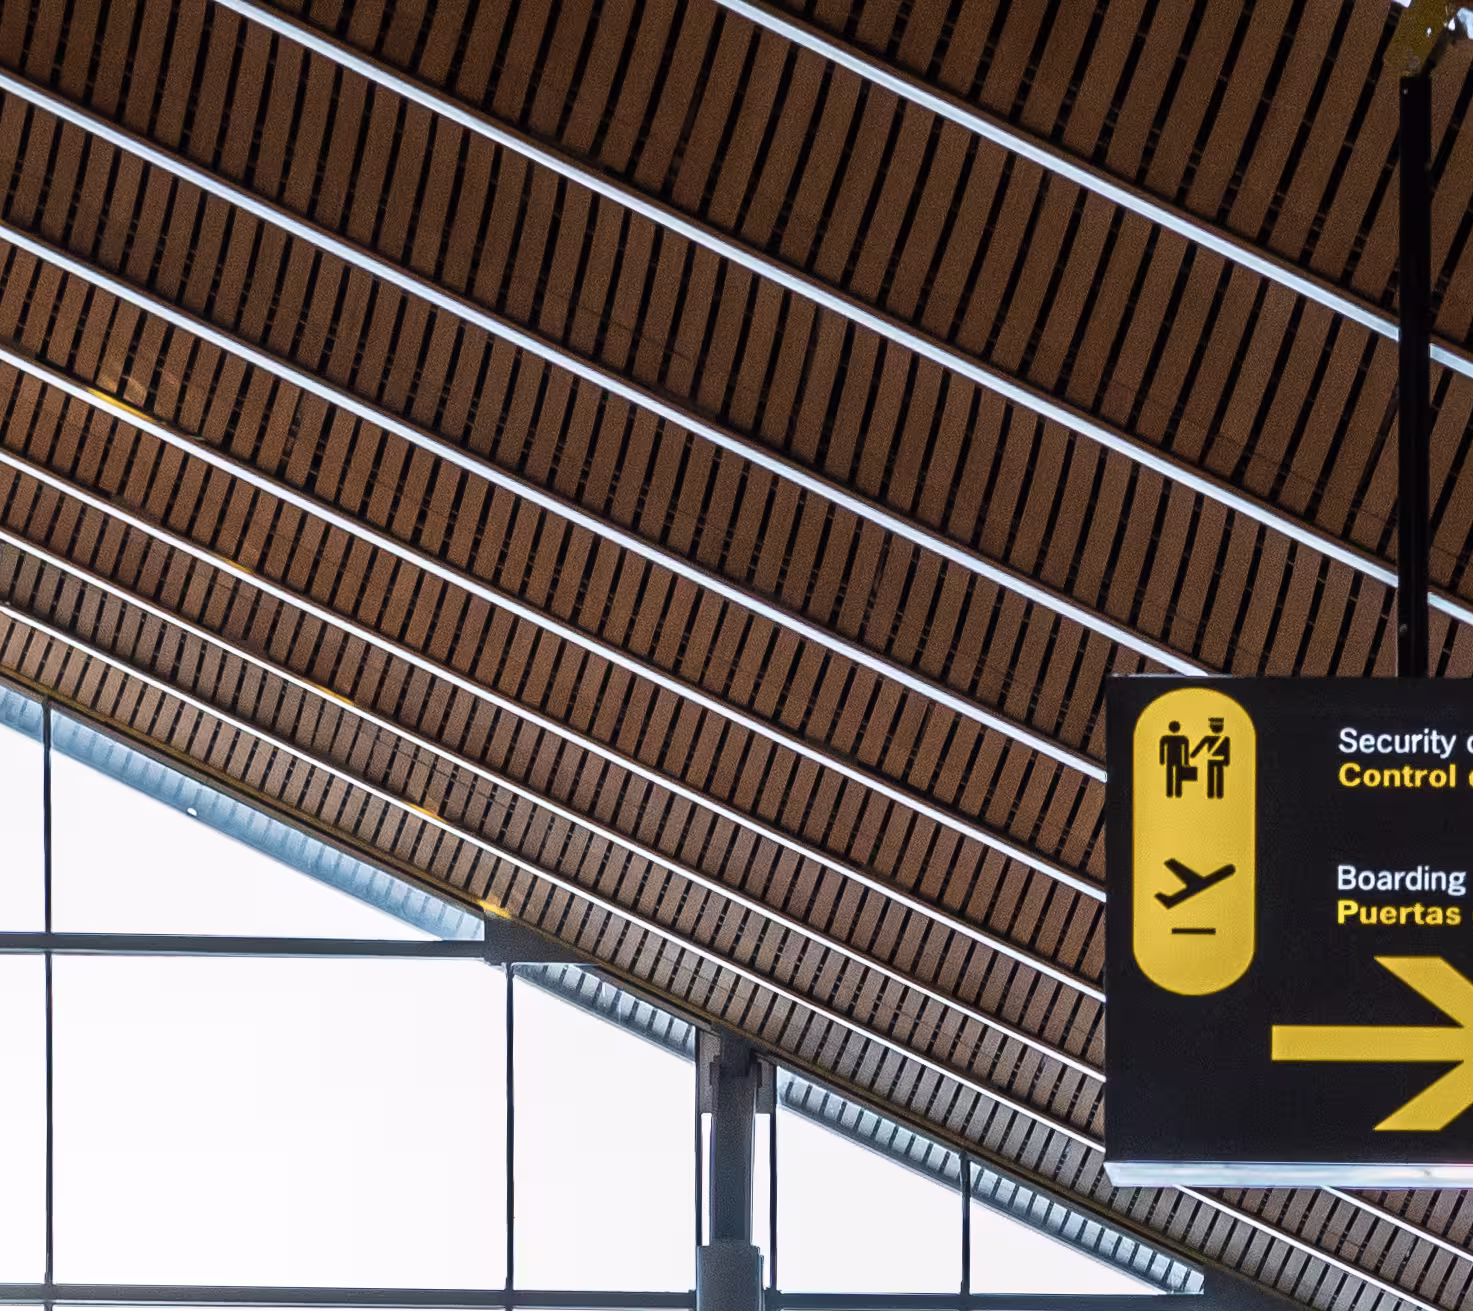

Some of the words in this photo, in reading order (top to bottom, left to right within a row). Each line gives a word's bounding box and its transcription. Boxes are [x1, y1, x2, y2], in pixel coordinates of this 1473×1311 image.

[1338, 727, 1457, 760] Security
[1338, 763, 1457, 789] Control
[1337, 864, 1467, 897] Boarding
[1337, 900, 1462, 926] Puertas
